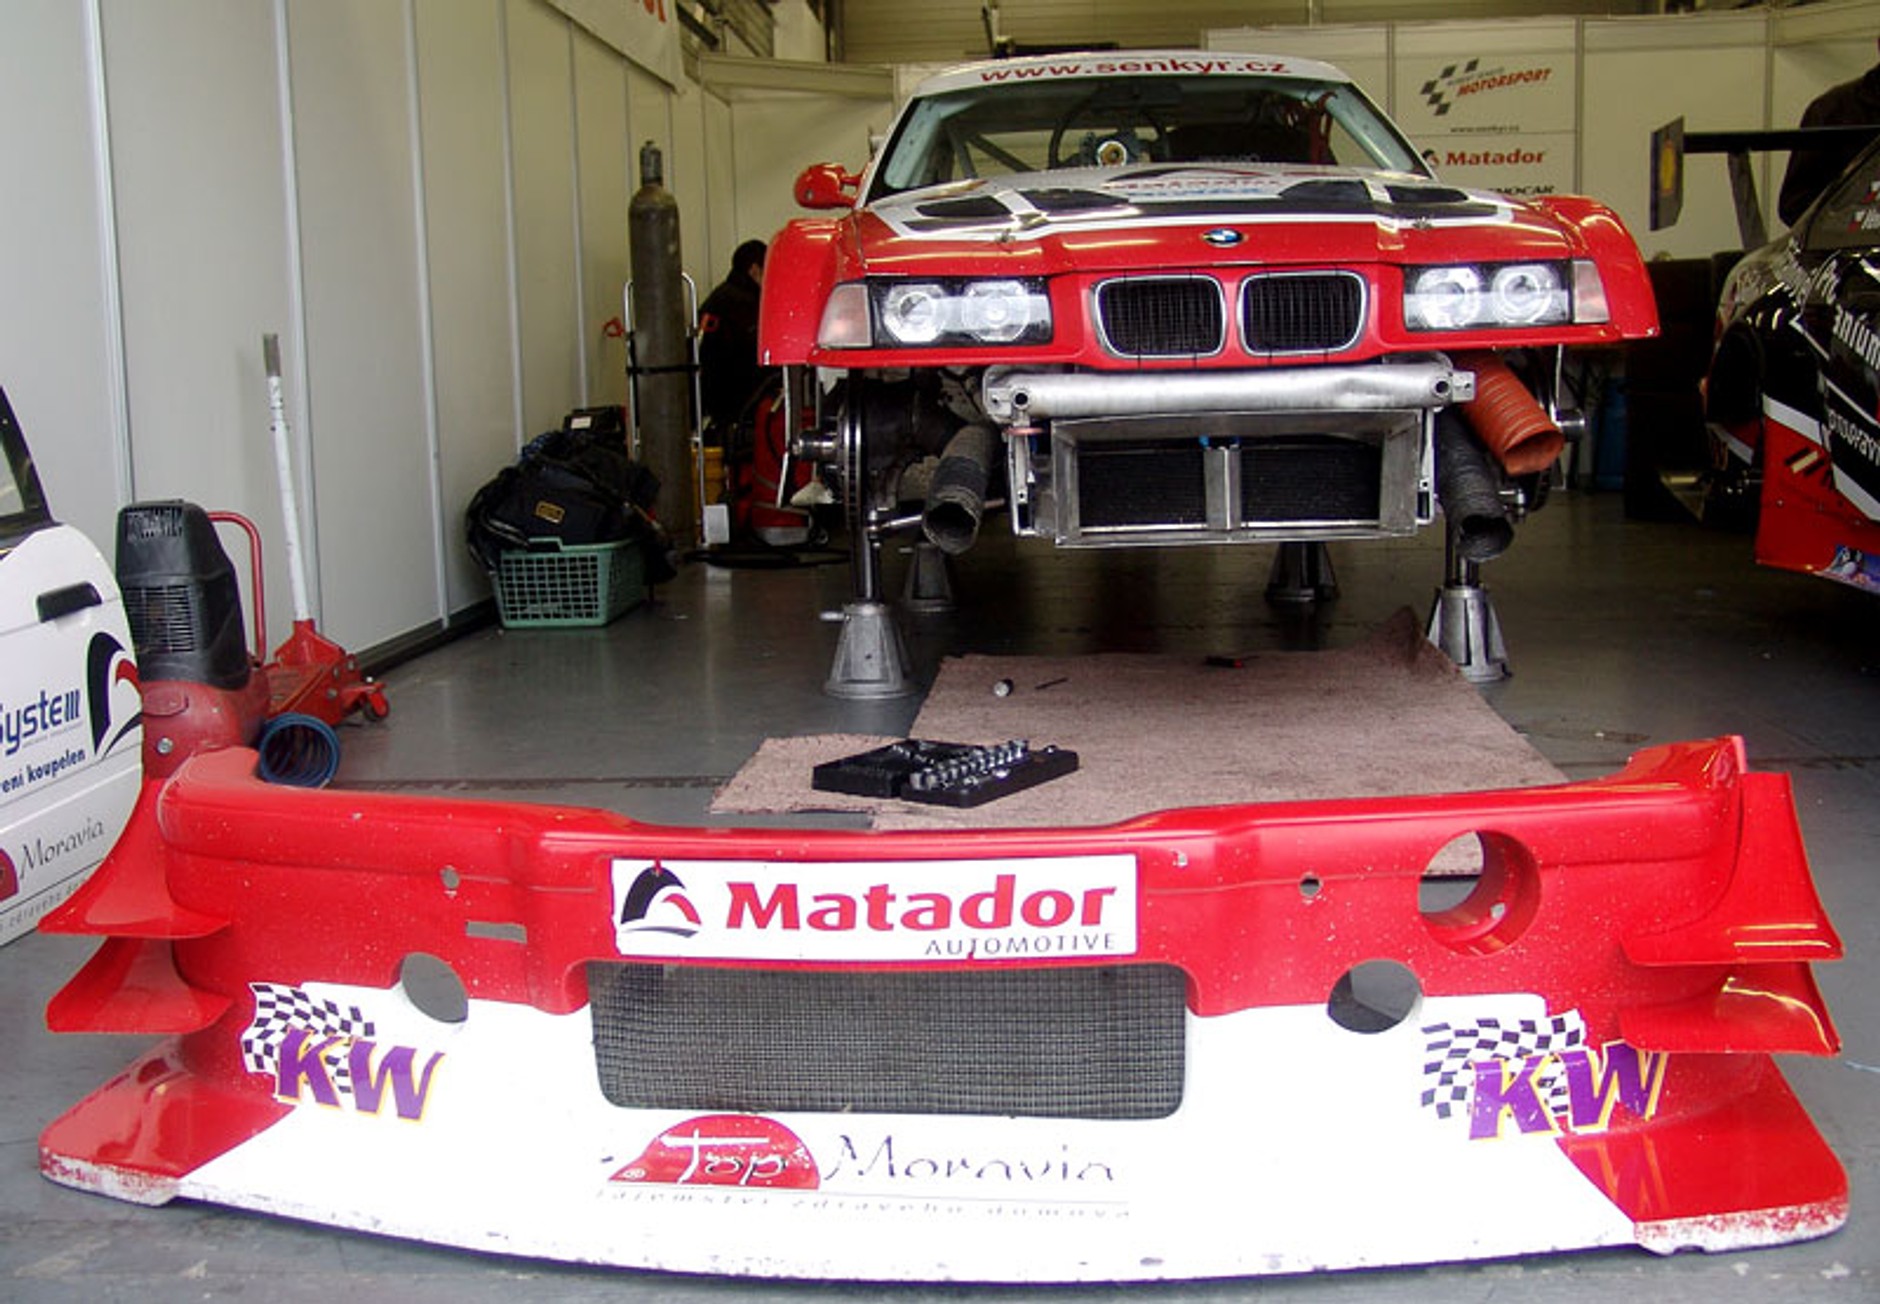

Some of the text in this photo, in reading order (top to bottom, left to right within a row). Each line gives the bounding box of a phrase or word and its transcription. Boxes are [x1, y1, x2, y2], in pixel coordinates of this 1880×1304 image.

[980, 58, 1291, 82] www.senkyr.cz
[1456, 67, 1552, 97] MOTORSPORT
[1445, 149, 1547, 166] Matador
[26, 749, 86, 783] koupelen
[19, 817, 104, 880] Moravia
[726, 874, 1118, 931] Matador
[924, 932, 1116, 957] AUTOMOTIVE
[276, 1025, 446, 1123] KW
[1468, 1039, 1670, 1142] KW
[661, 1128, 1115, 1186] Top Moravia
